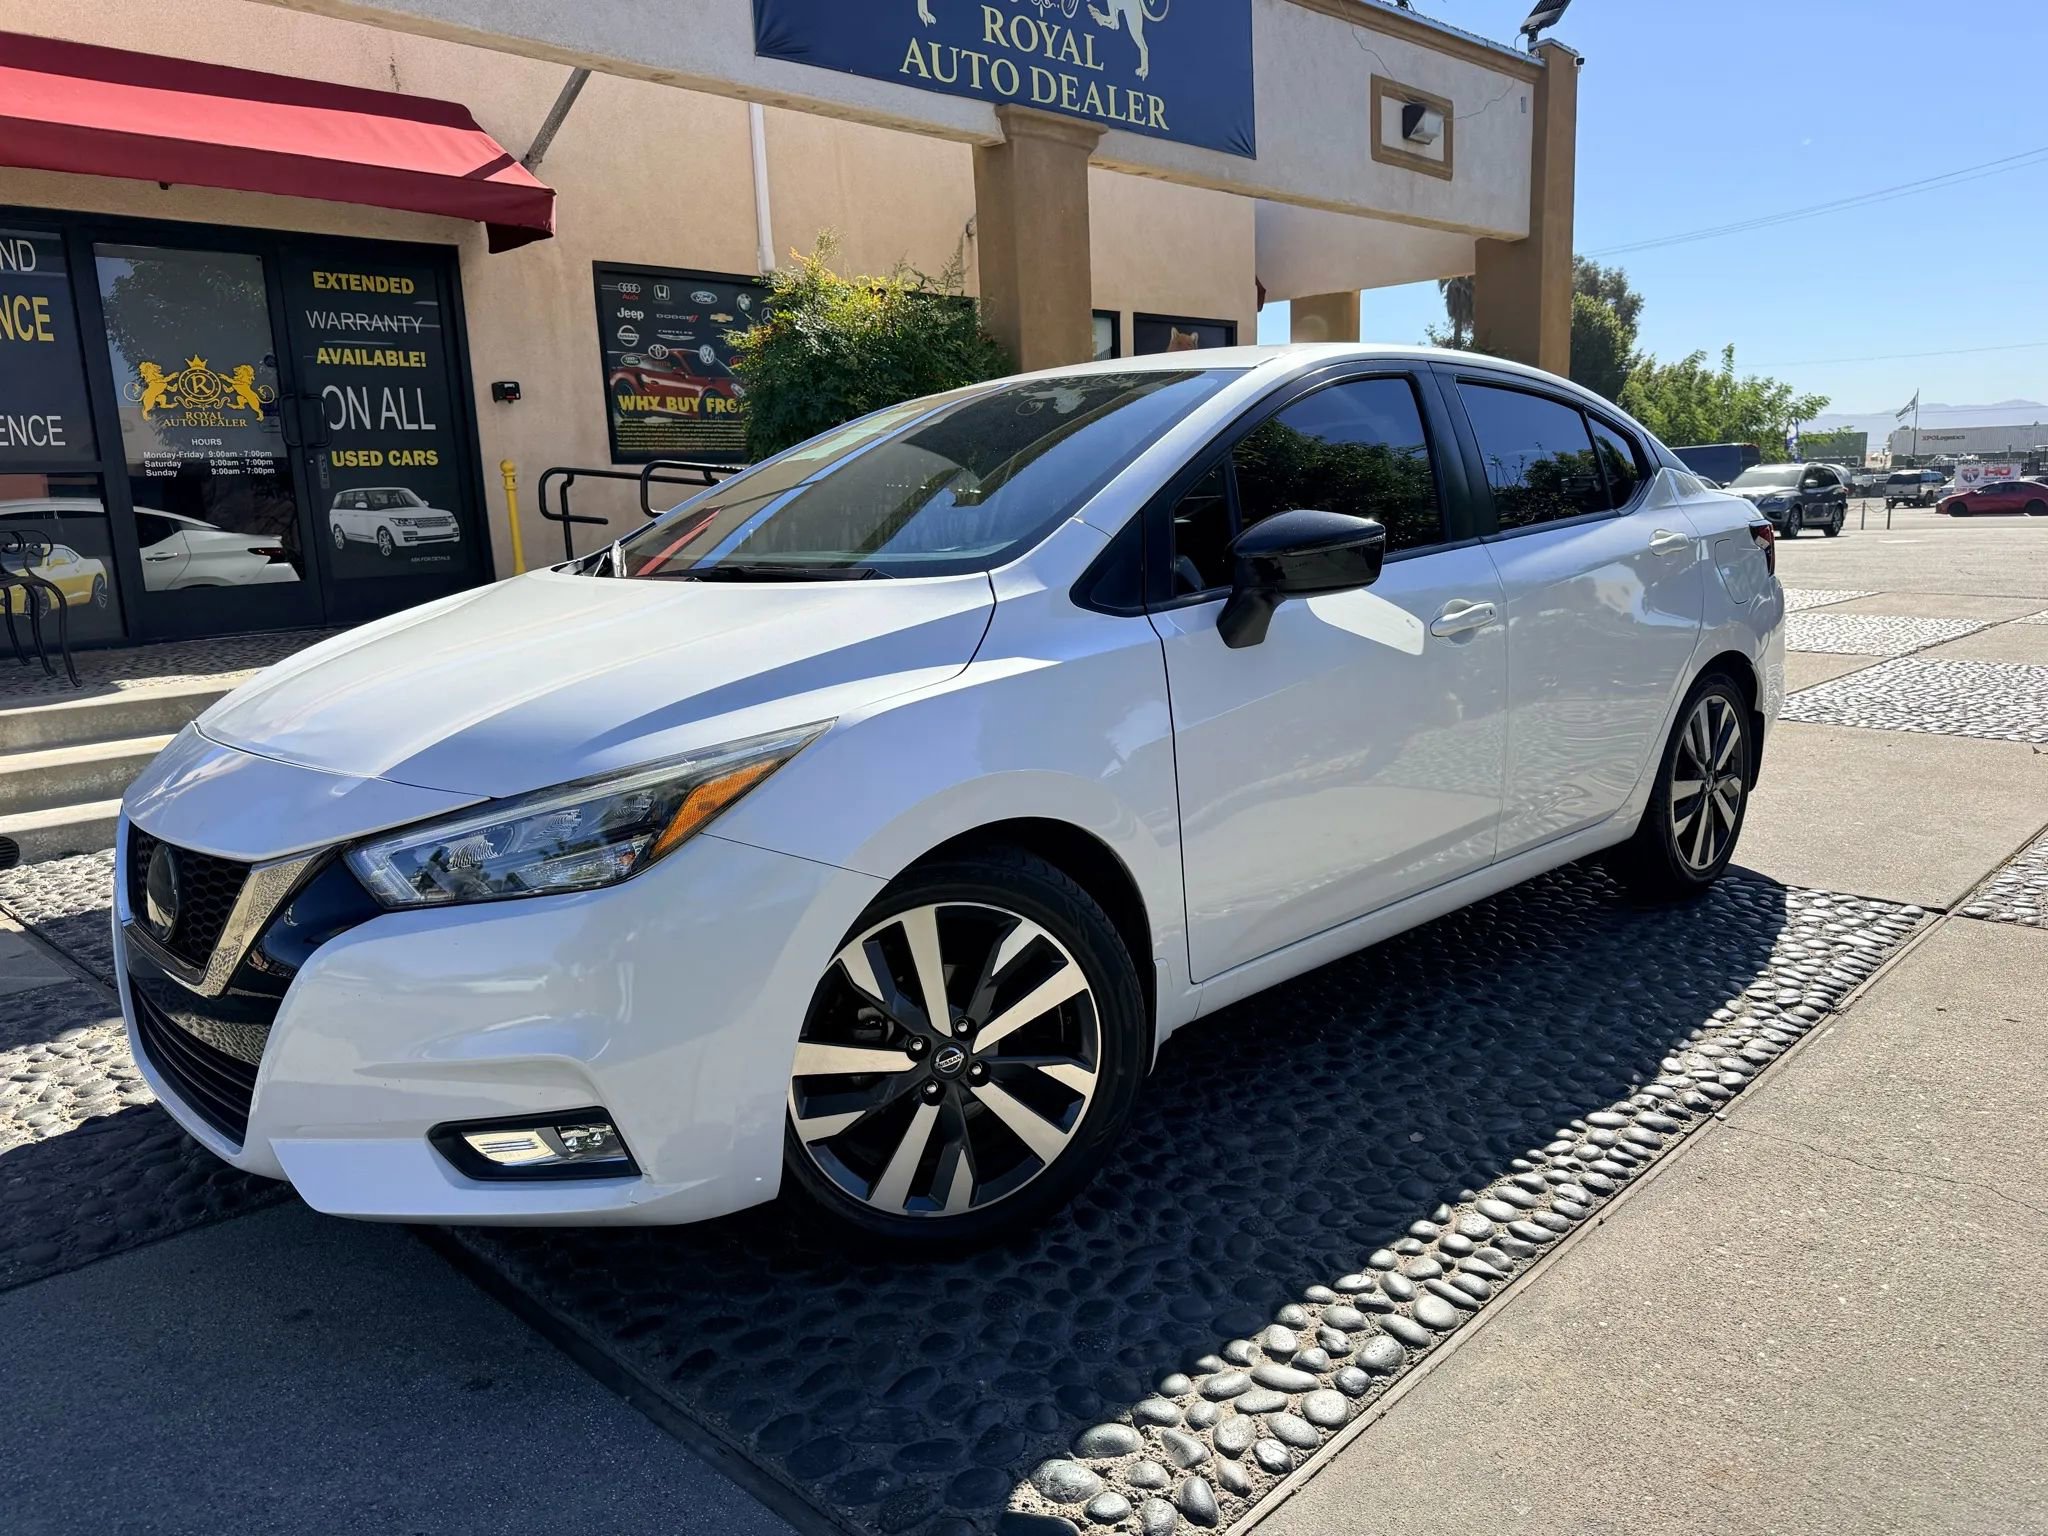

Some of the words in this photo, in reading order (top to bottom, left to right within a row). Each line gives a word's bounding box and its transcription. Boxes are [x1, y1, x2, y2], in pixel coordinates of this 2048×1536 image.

[980, 3, 1104, 71] ROYAL
[899, 37, 1020, 96] AUTO
[1029, 65, 1170, 131] DEALER
[312, 271, 415, 295] EXTENDED
[305, 309, 423, 334] WARRANTY
[616, 307, 644, 321] Jeep
[316, 347, 427, 368] AVAILABLE!
[321, 384, 372, 430] ON
[380, 387, 436, 430] ALL
[617, 395, 661, 411] WHY
[665, 396, 701, 412] BUY
[163, 419, 198, 427] AUTO
[201, 419, 248, 427] DEALER
[185, 411, 225, 420] ROYAL
[191, 438, 222, 446] HOURS
[143, 451, 204, 460] Monday-Friday
[208, 450, 237, 458] 9:00am
[243, 450, 272, 459] 7:00pm
[331, 450, 383, 467] USED
[387, 449, 439, 466] CARS
[144, 460, 182, 469] Saturday
[210, 459, 239, 467] 9:00am
[245, 459, 273, 468] 7:00pm
[146, 469, 178, 478] Sunday
[211, 468, 240, 476] 9:00am
[246, 467, 275, 476] 7:00pm
[937, 1054, 962, 1068] NISSAN
